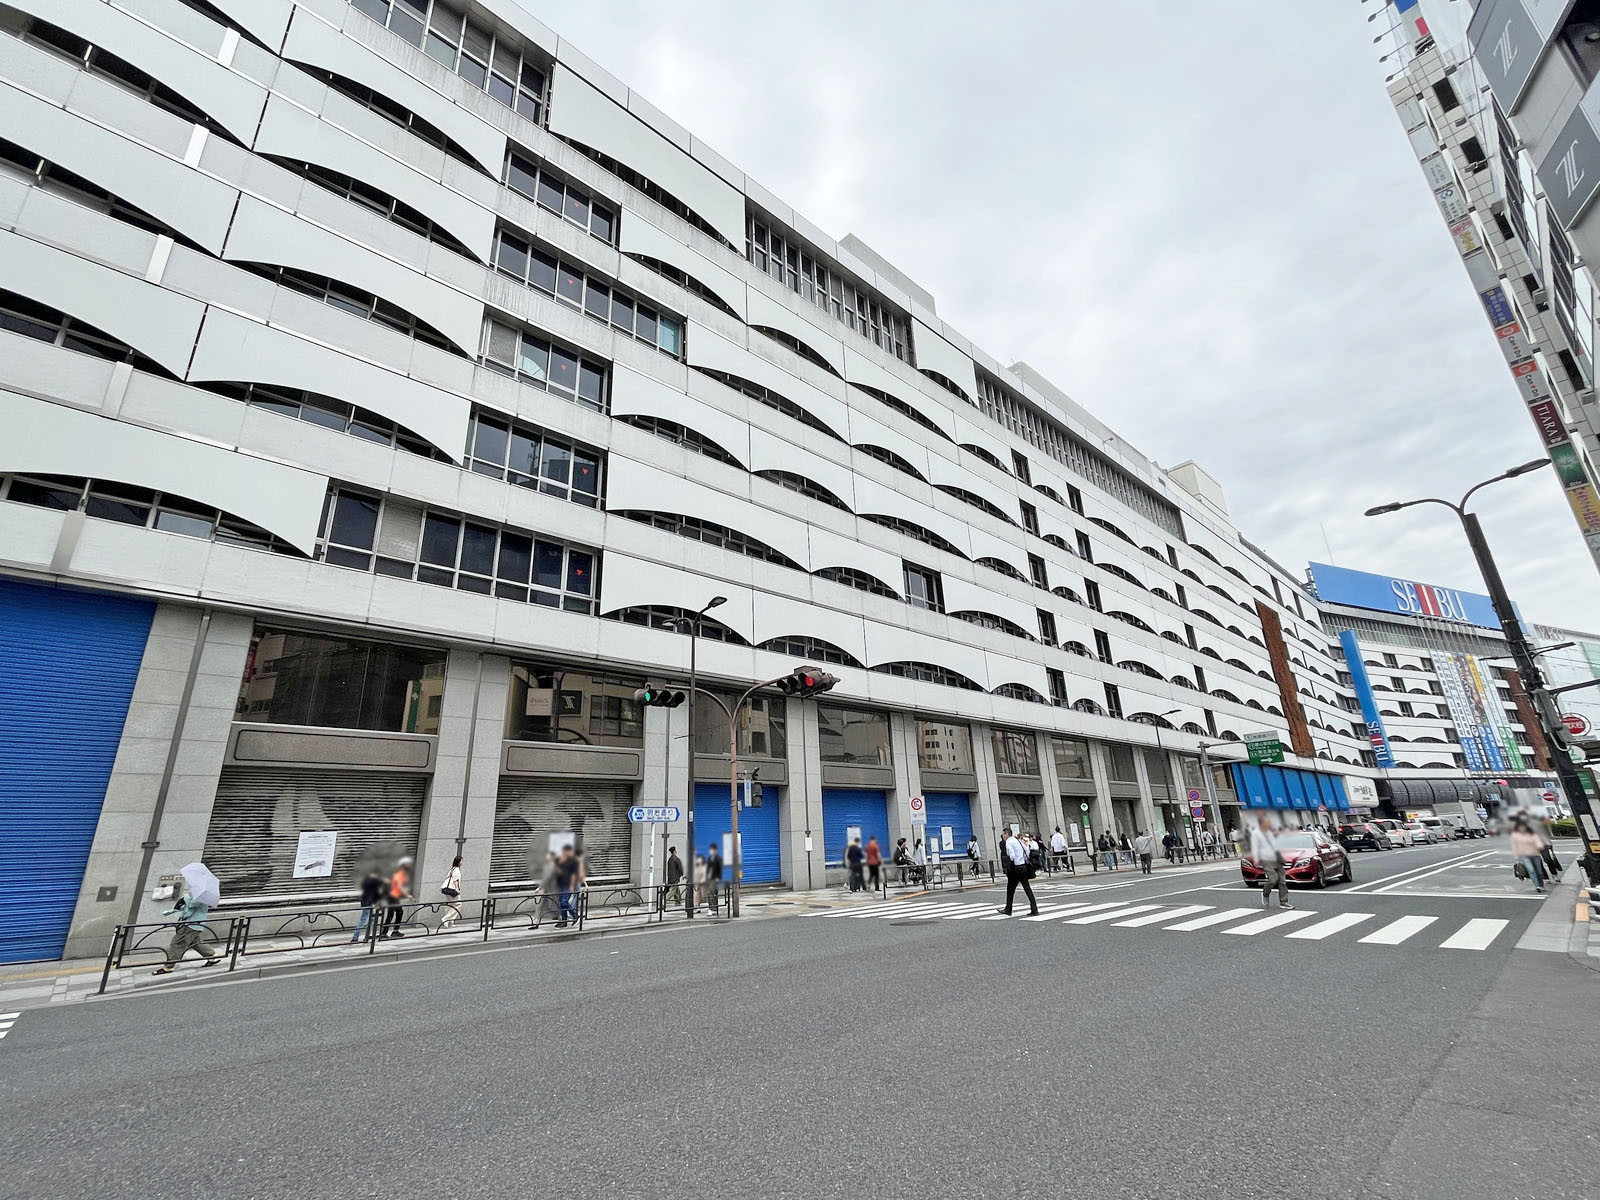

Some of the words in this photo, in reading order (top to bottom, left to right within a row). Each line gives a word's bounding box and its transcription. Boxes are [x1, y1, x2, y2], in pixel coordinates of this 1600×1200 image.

[1537, 404, 1557, 437] TIARA
[1391, 579, 1469, 622] SEIBU
[1367, 721, 1389, 762] SEIBU
